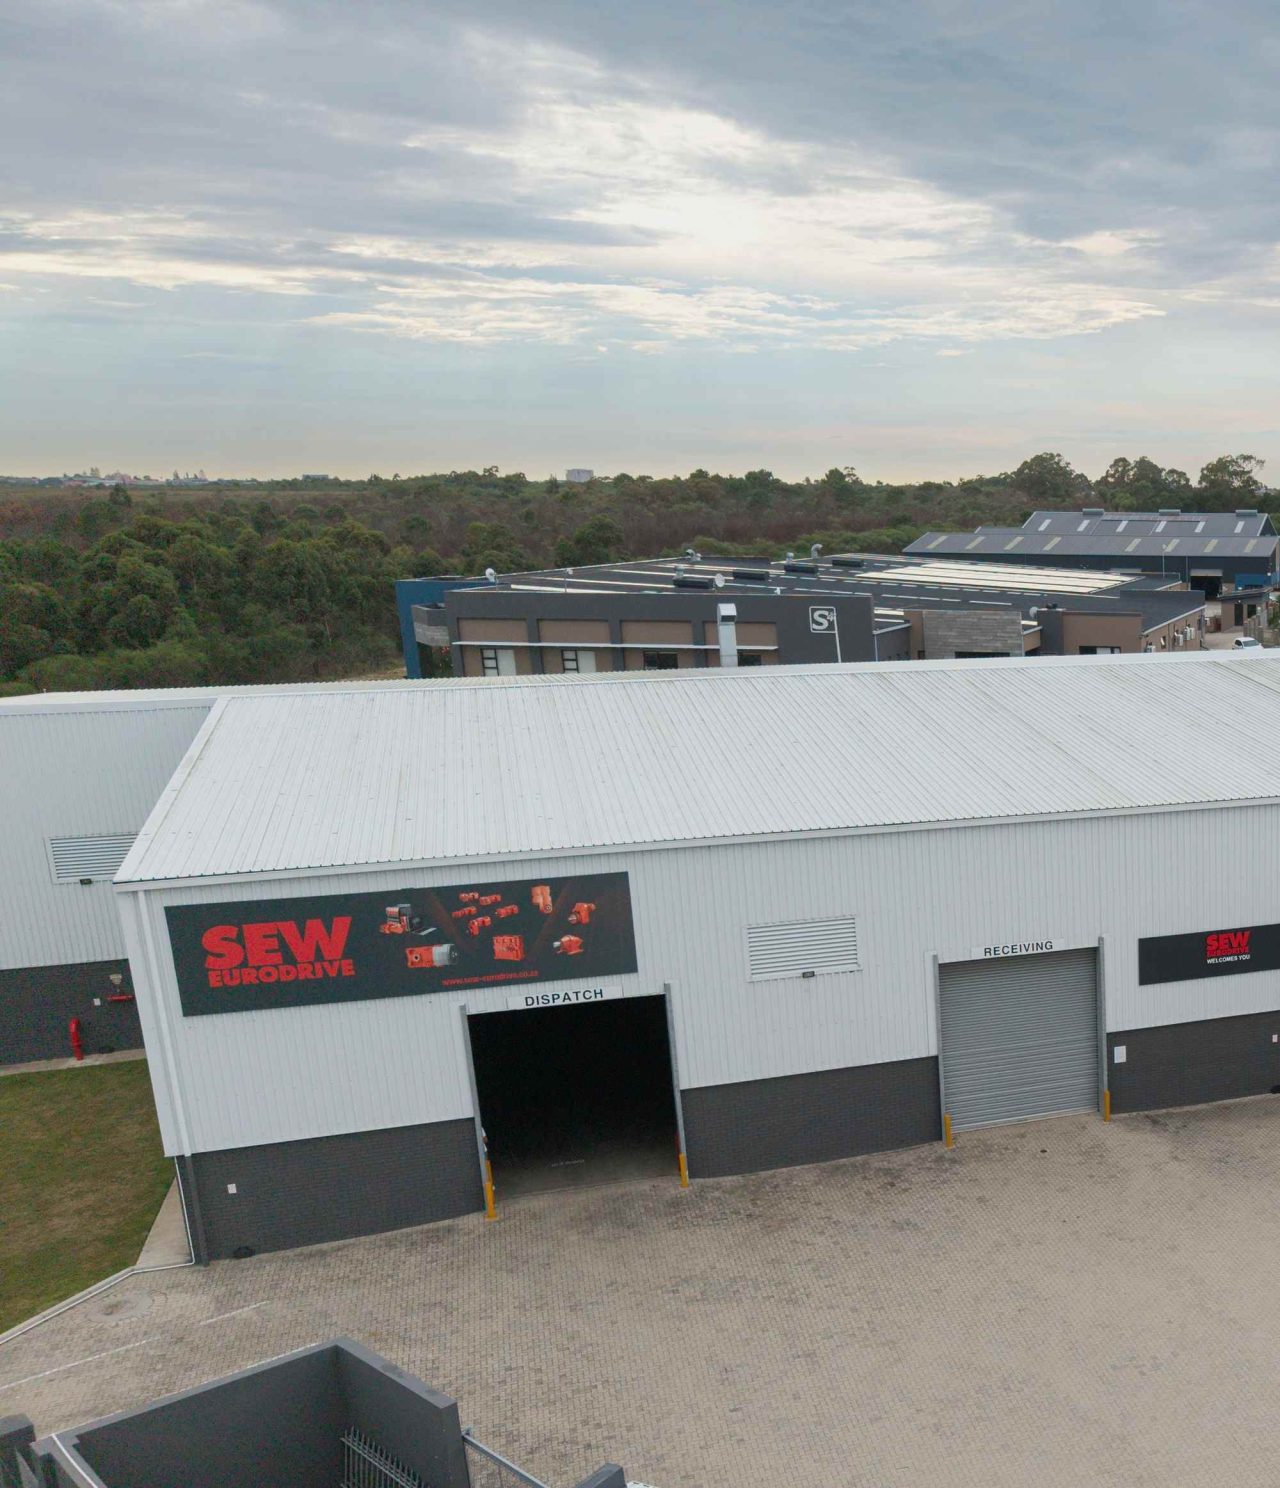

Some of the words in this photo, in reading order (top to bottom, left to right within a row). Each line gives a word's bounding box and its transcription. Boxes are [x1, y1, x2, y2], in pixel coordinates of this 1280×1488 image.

[201, 916, 353, 970] SEW
[984, 940, 1053, 957] RECEIVING
[1206, 931, 1250, 952] SEW
[1207, 955, 1238, 964] WELCOMES
[207, 959, 356, 988] EURODRIVE
[525, 988, 604, 1007] DISPATCH
